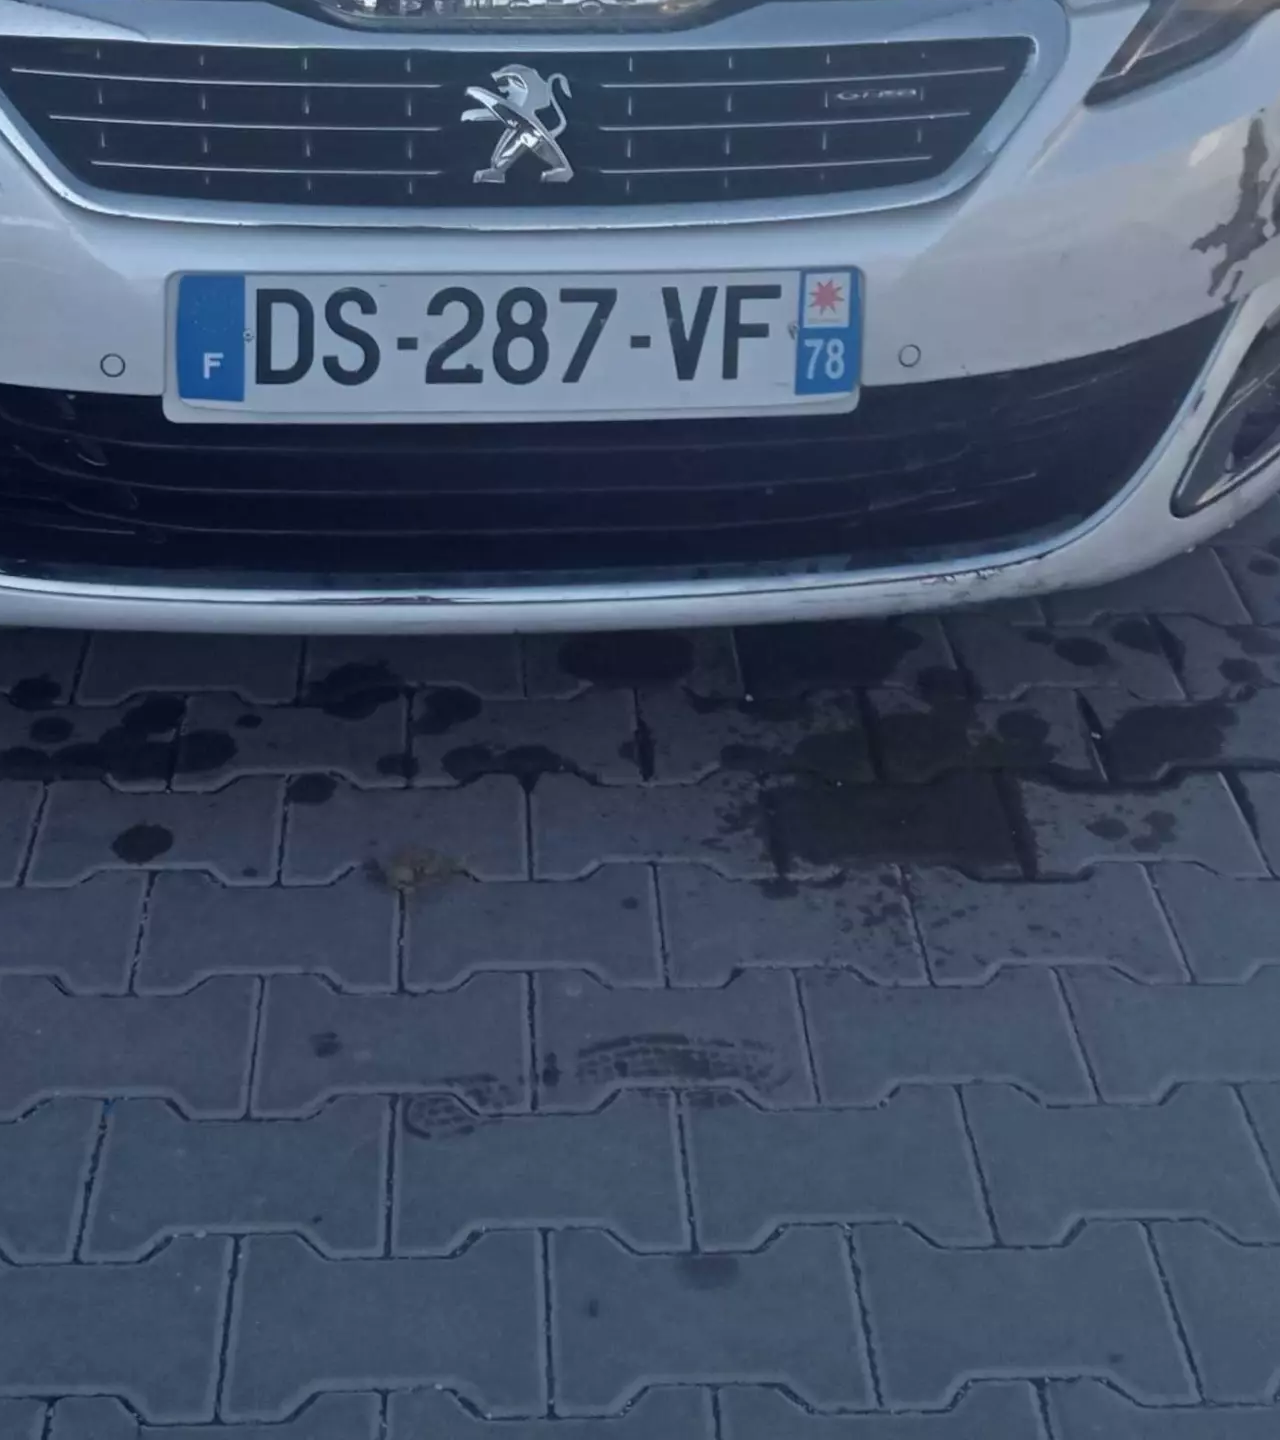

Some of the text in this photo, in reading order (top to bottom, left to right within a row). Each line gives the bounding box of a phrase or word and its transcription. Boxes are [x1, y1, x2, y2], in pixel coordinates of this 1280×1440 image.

[255, 284, 782, 386] DS-287-VF
[202, 352, 224, 379] F
[804, 338, 845, 380] 78
